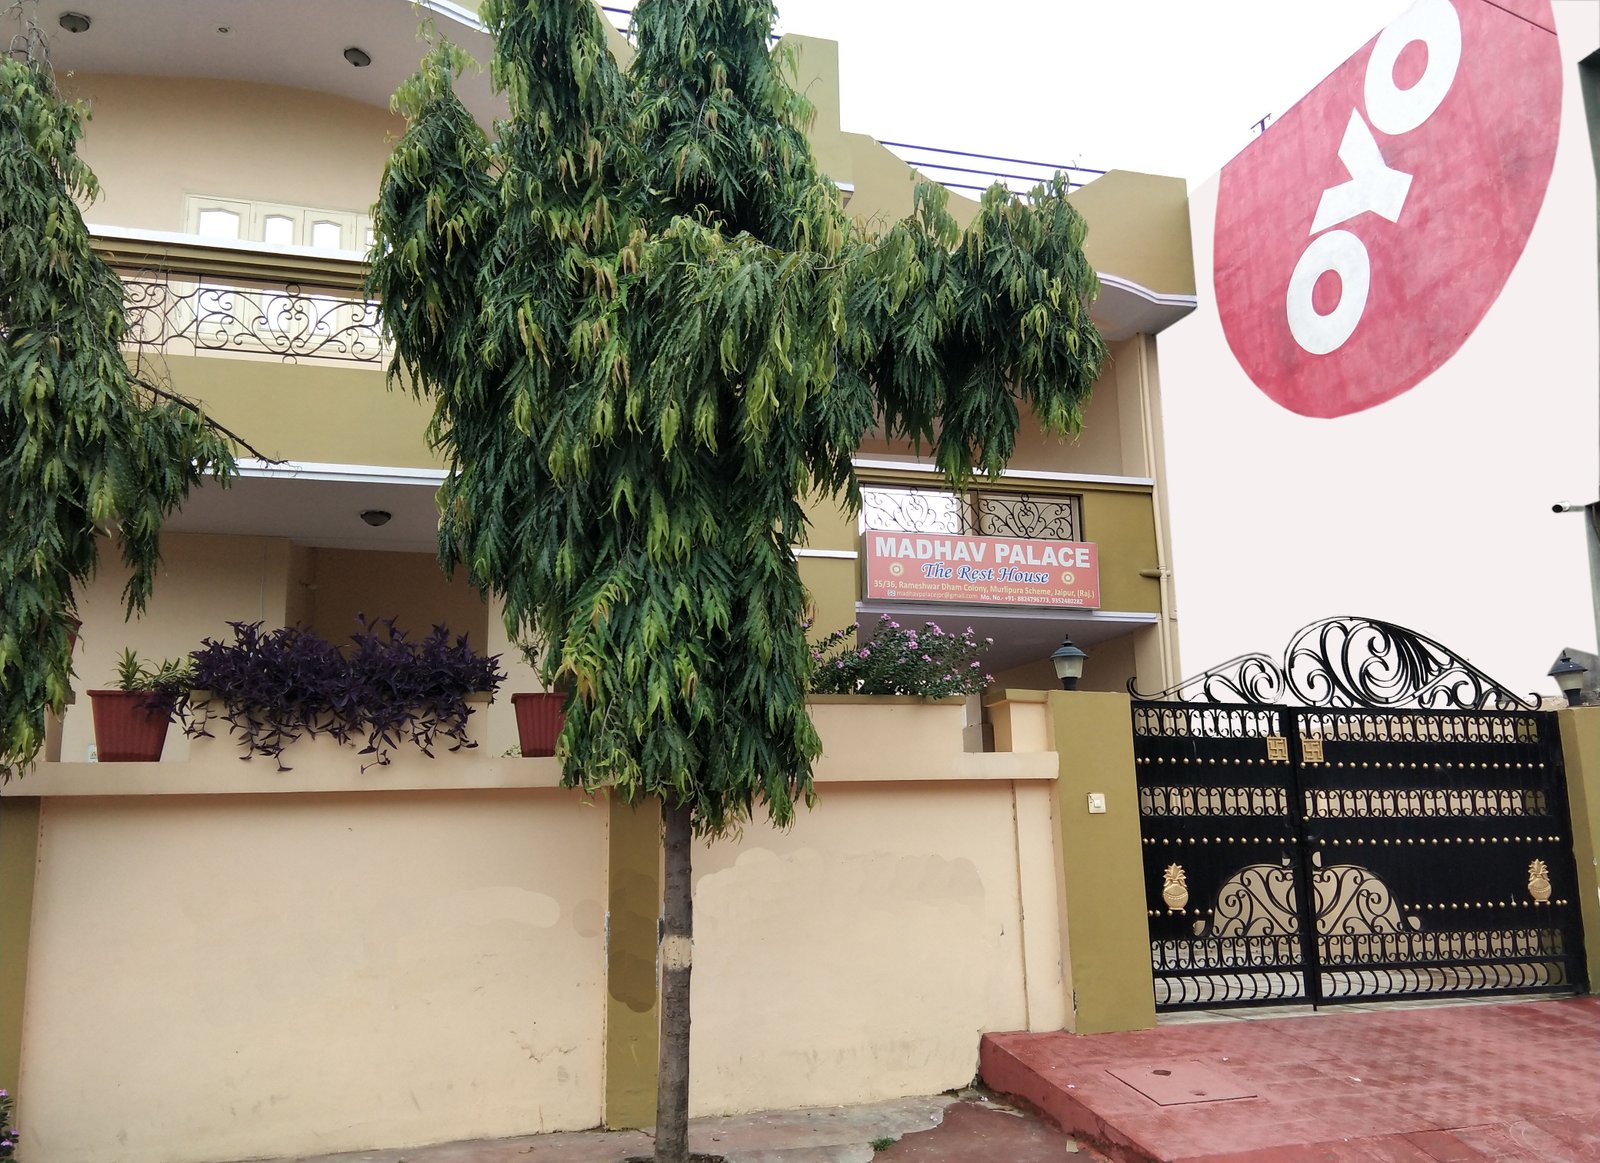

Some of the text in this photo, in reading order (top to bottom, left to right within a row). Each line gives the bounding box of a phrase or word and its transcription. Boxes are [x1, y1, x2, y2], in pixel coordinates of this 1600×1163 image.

[1287, 0, 1462, 354] OYO
[875, 536, 1090, 568] MADHAV PALACE
[921, 562, 1050, 583] The Rest House
[874, 580, 898, 589] 35/36,
[899, 581, 940, 591] Rameshwar
[941, 583, 962, 591] Dham
[963, 585, 989, 594] Colony,
[990, 585, 1024, 594] Murlipura
[1025, 587, 1053, 596] Scheme,
[1054, 589, 1076, 598] Jaipur,
